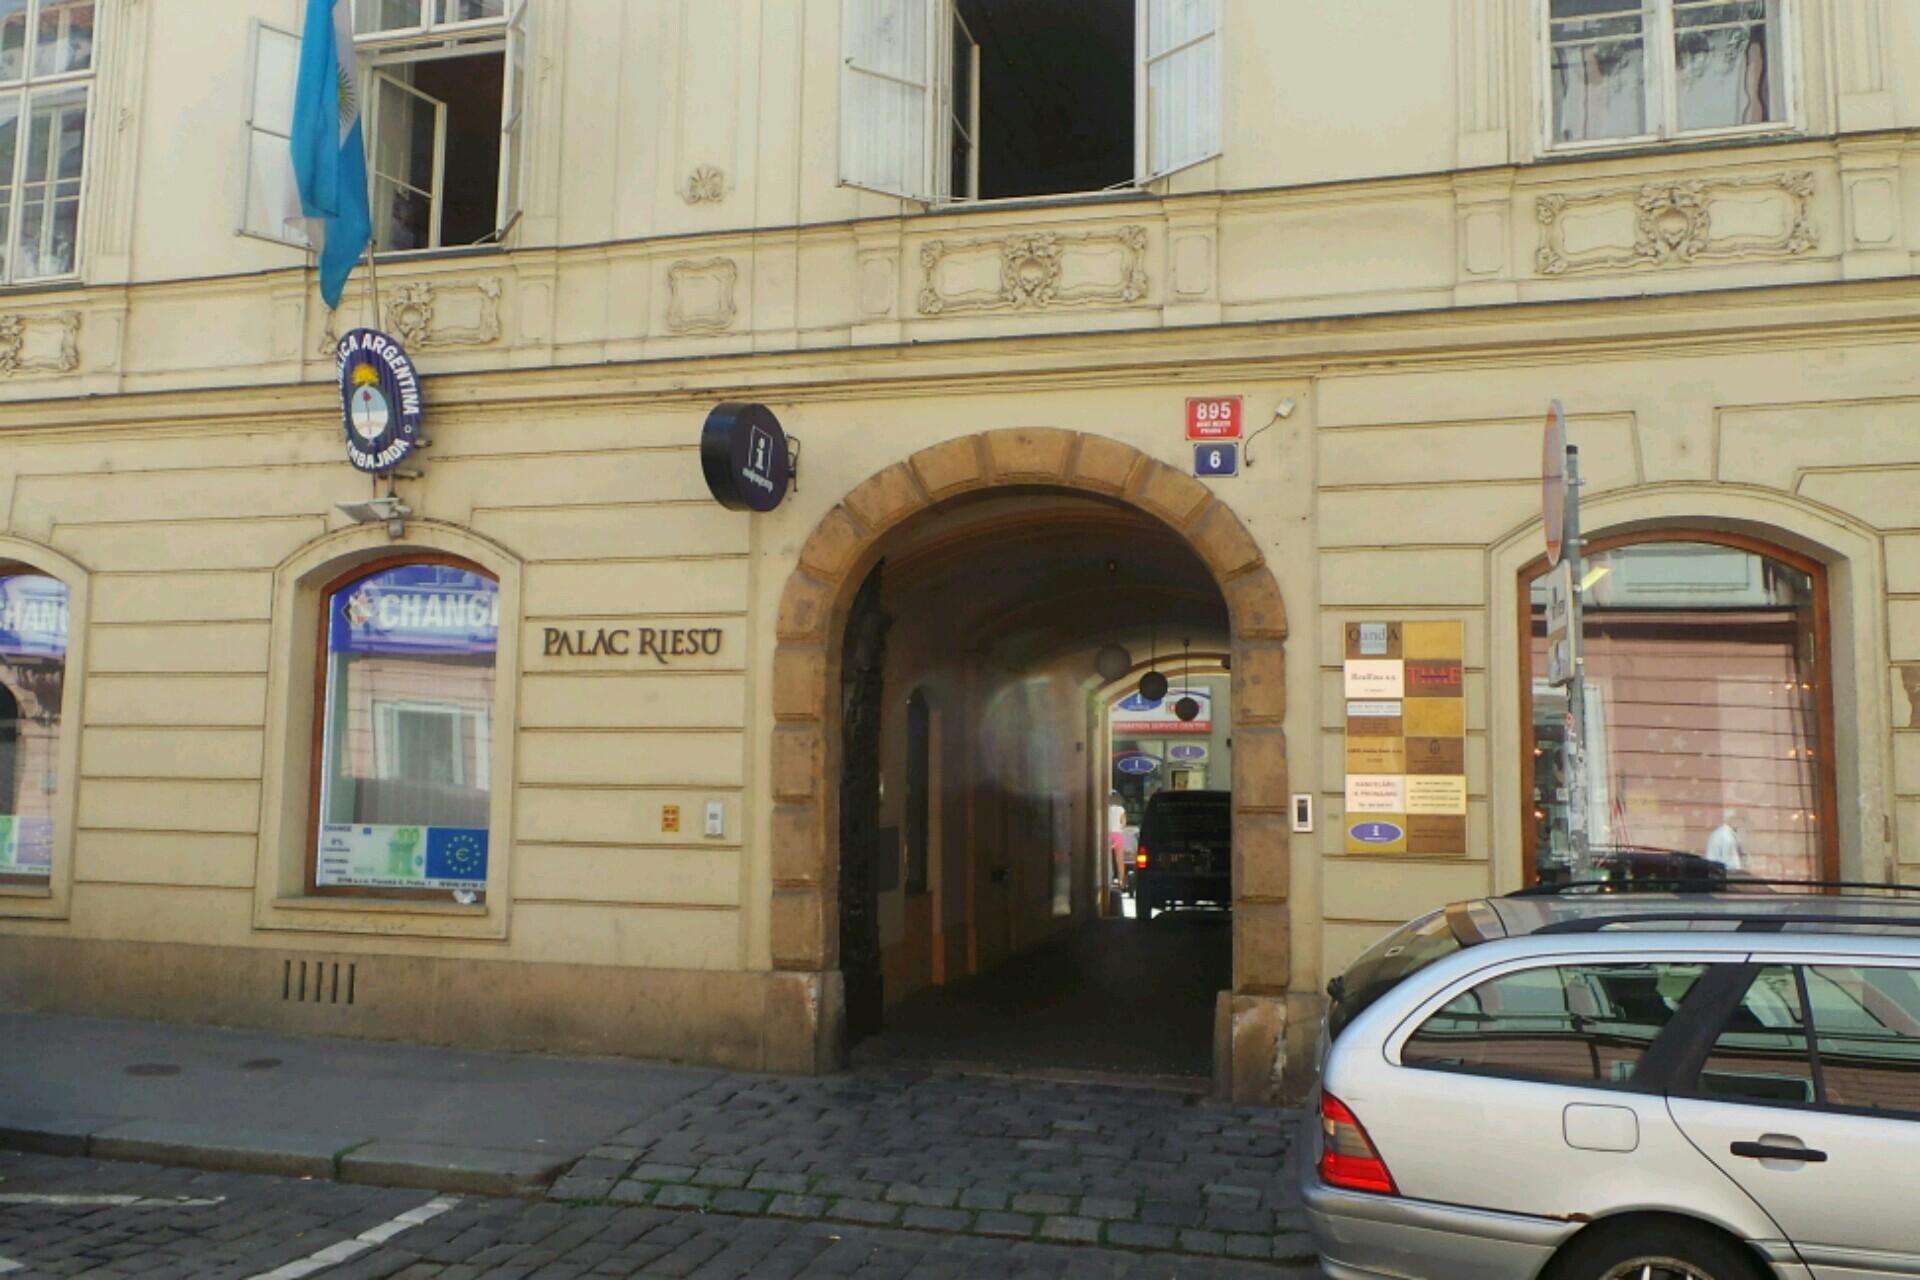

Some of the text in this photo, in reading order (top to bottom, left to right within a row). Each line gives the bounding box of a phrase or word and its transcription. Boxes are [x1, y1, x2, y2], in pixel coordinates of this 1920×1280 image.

[361, 333, 420, 415] ARGENTINA
[1196, 402, 1232, 420] 895
[1210, 450, 1221, 469] 6
